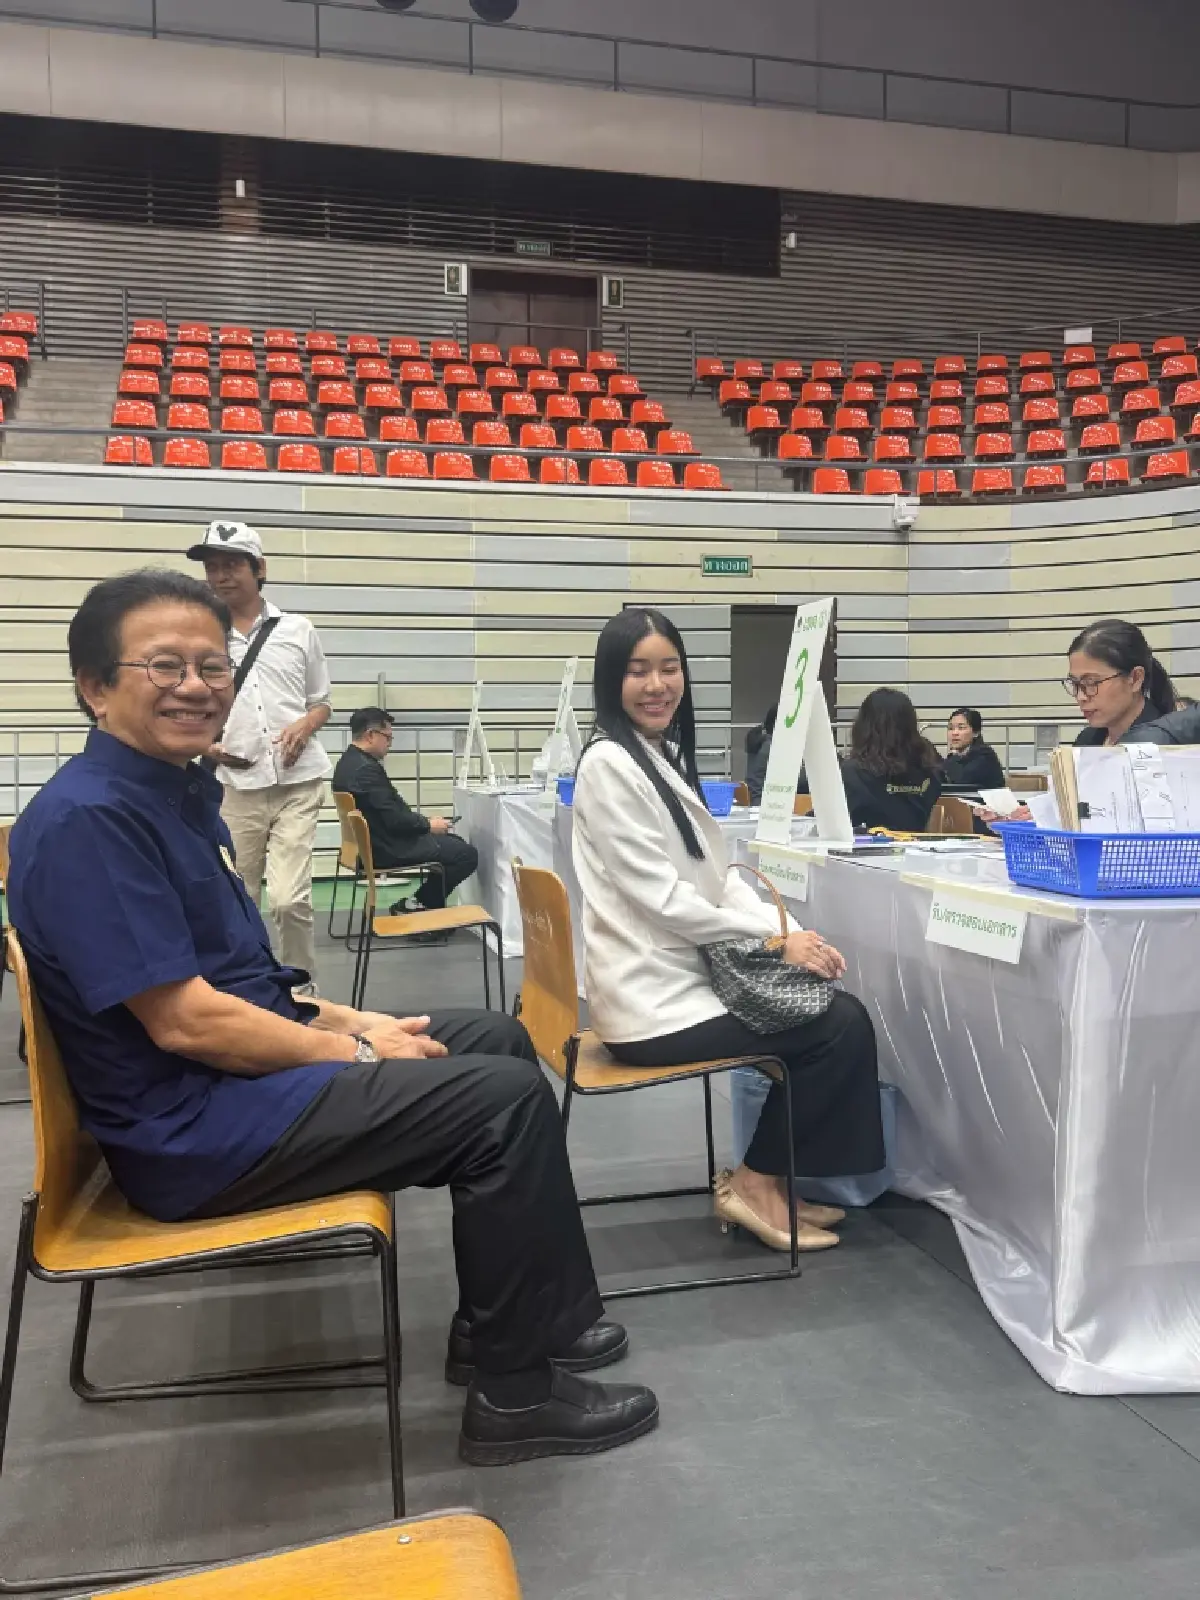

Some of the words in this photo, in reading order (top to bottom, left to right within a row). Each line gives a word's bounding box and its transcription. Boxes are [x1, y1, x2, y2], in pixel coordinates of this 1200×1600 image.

[704, 560, 748, 571] ทางออก
[784, 647, 809, 729] 3
